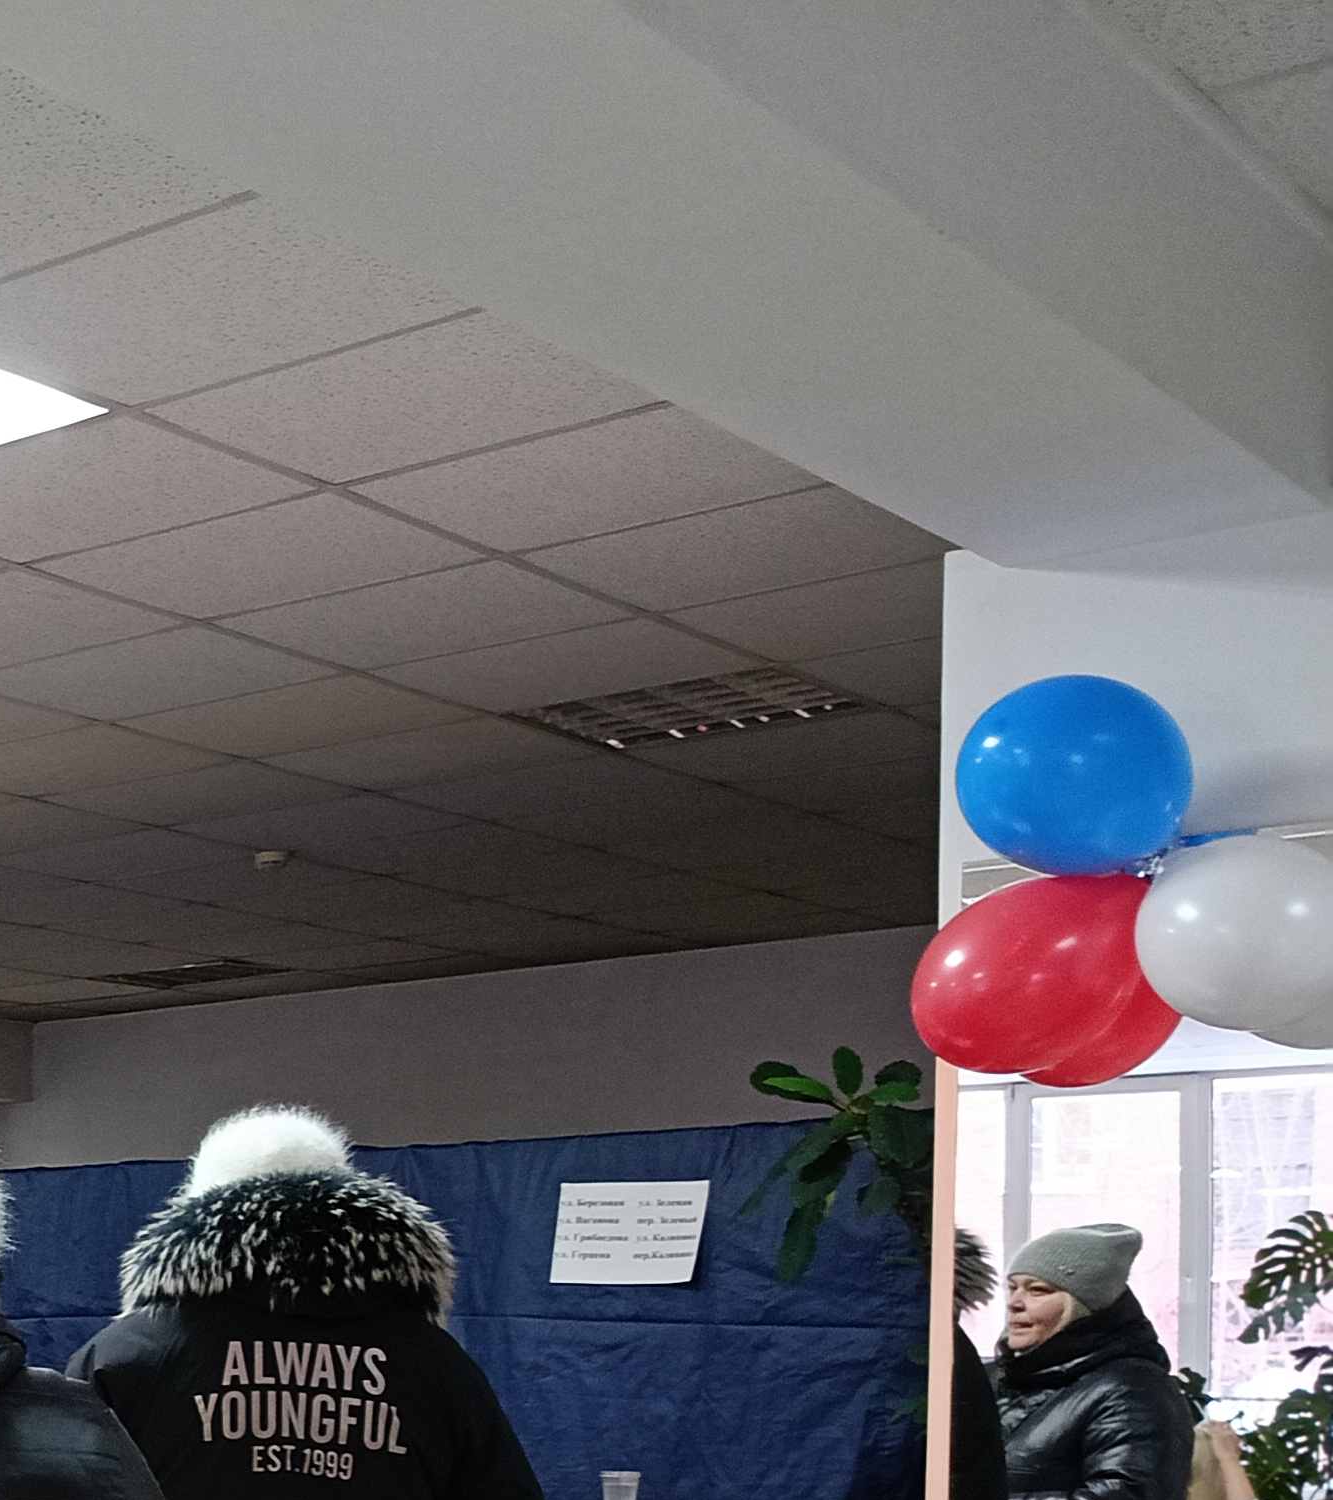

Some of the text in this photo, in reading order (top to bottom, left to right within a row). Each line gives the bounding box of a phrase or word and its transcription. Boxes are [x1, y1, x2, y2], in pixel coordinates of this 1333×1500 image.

[221, 1340, 387, 1396] ALWAYS
[193, 1390, 408, 1455] YOUNGFUL
[251, 1444, 354, 1481] EST.1999
